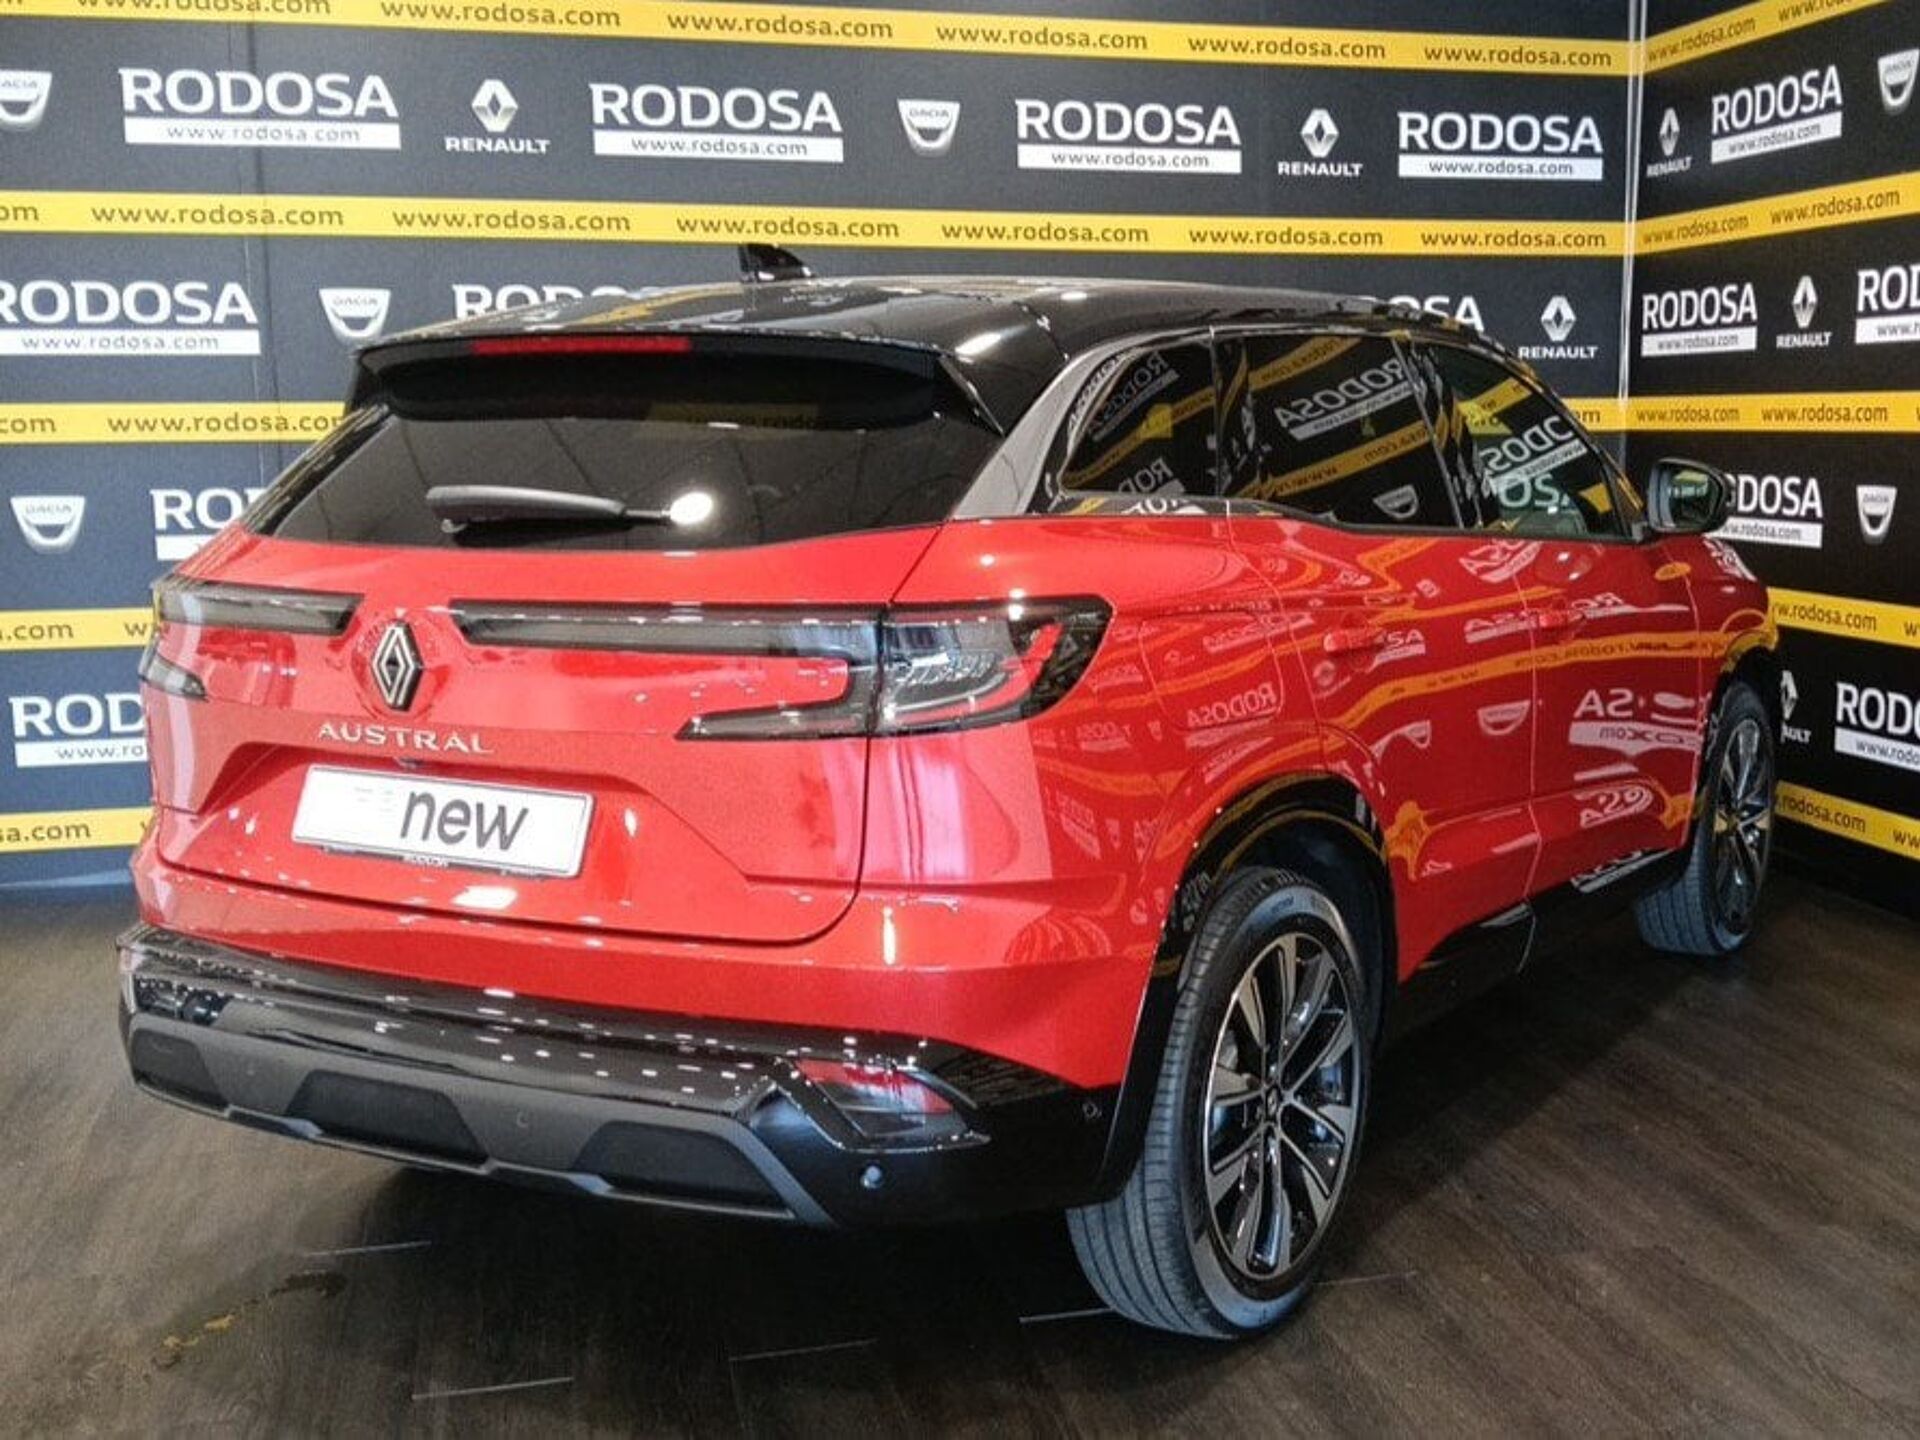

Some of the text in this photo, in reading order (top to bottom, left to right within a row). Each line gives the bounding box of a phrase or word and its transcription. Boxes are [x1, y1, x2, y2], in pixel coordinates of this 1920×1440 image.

[382, 2, 621, 27] www.rodosa.com
[668, 14, 893, 39] www.rodosa.com
[936, 25, 1148, 50] www.rodosa.com
[1188, 35, 1386, 60] www.rodosa.com
[1424, 45, 1612, 67] www.rodosa.com
[119, 68, 399, 117] RODOSA
[589, 83, 843, 132] RODOSA
[1711, 64, 1843, 135] RODOSA
[168, 125, 361, 143] www.rodosa.com
[1015, 99, 1241, 145] RODOSA
[1397, 111, 1603, 153] RODOSA
[445, 136, 550, 154] RENAULT
[631, 138, 808, 156] www.rodosa.com
[1728, 123, 1821, 155] www.rodosa.com
[1051, 151, 1210, 168] www.rodosa.com
[1278, 161, 1363, 177] RENAULT
[1428, 158, 1573, 176] www.rodosa.com
[1647, 156, 1692, 178] RENAULT
[1770, 189, 1900, 225] www.rodosa.com
[91, 204, 1607, 248] www.rodosa.com www.rodosa.com www.rodosa.com www.rodosa.com www.rodosa.com www.rodosa.com
[1641, 281, 1758, 331] RODOSA
[21, 335, 219, 351] www.rodosa.com
[1518, 347, 1598, 359] RENAULT
[1776, 331, 1832, 349] RENAULT
[1637, 403, 1888, 422] www.rodosa.com www.rodosa.com
[1774, 602, 1877, 633] w.rodosa.com
[8, 692, 146, 737] ROD
[1835, 681, 1920, 741] ROD
[318, 721, 494, 754] AUSTRAL
[400, 790, 529, 851] new
[1782, 795, 1866, 834] rodosa.com
